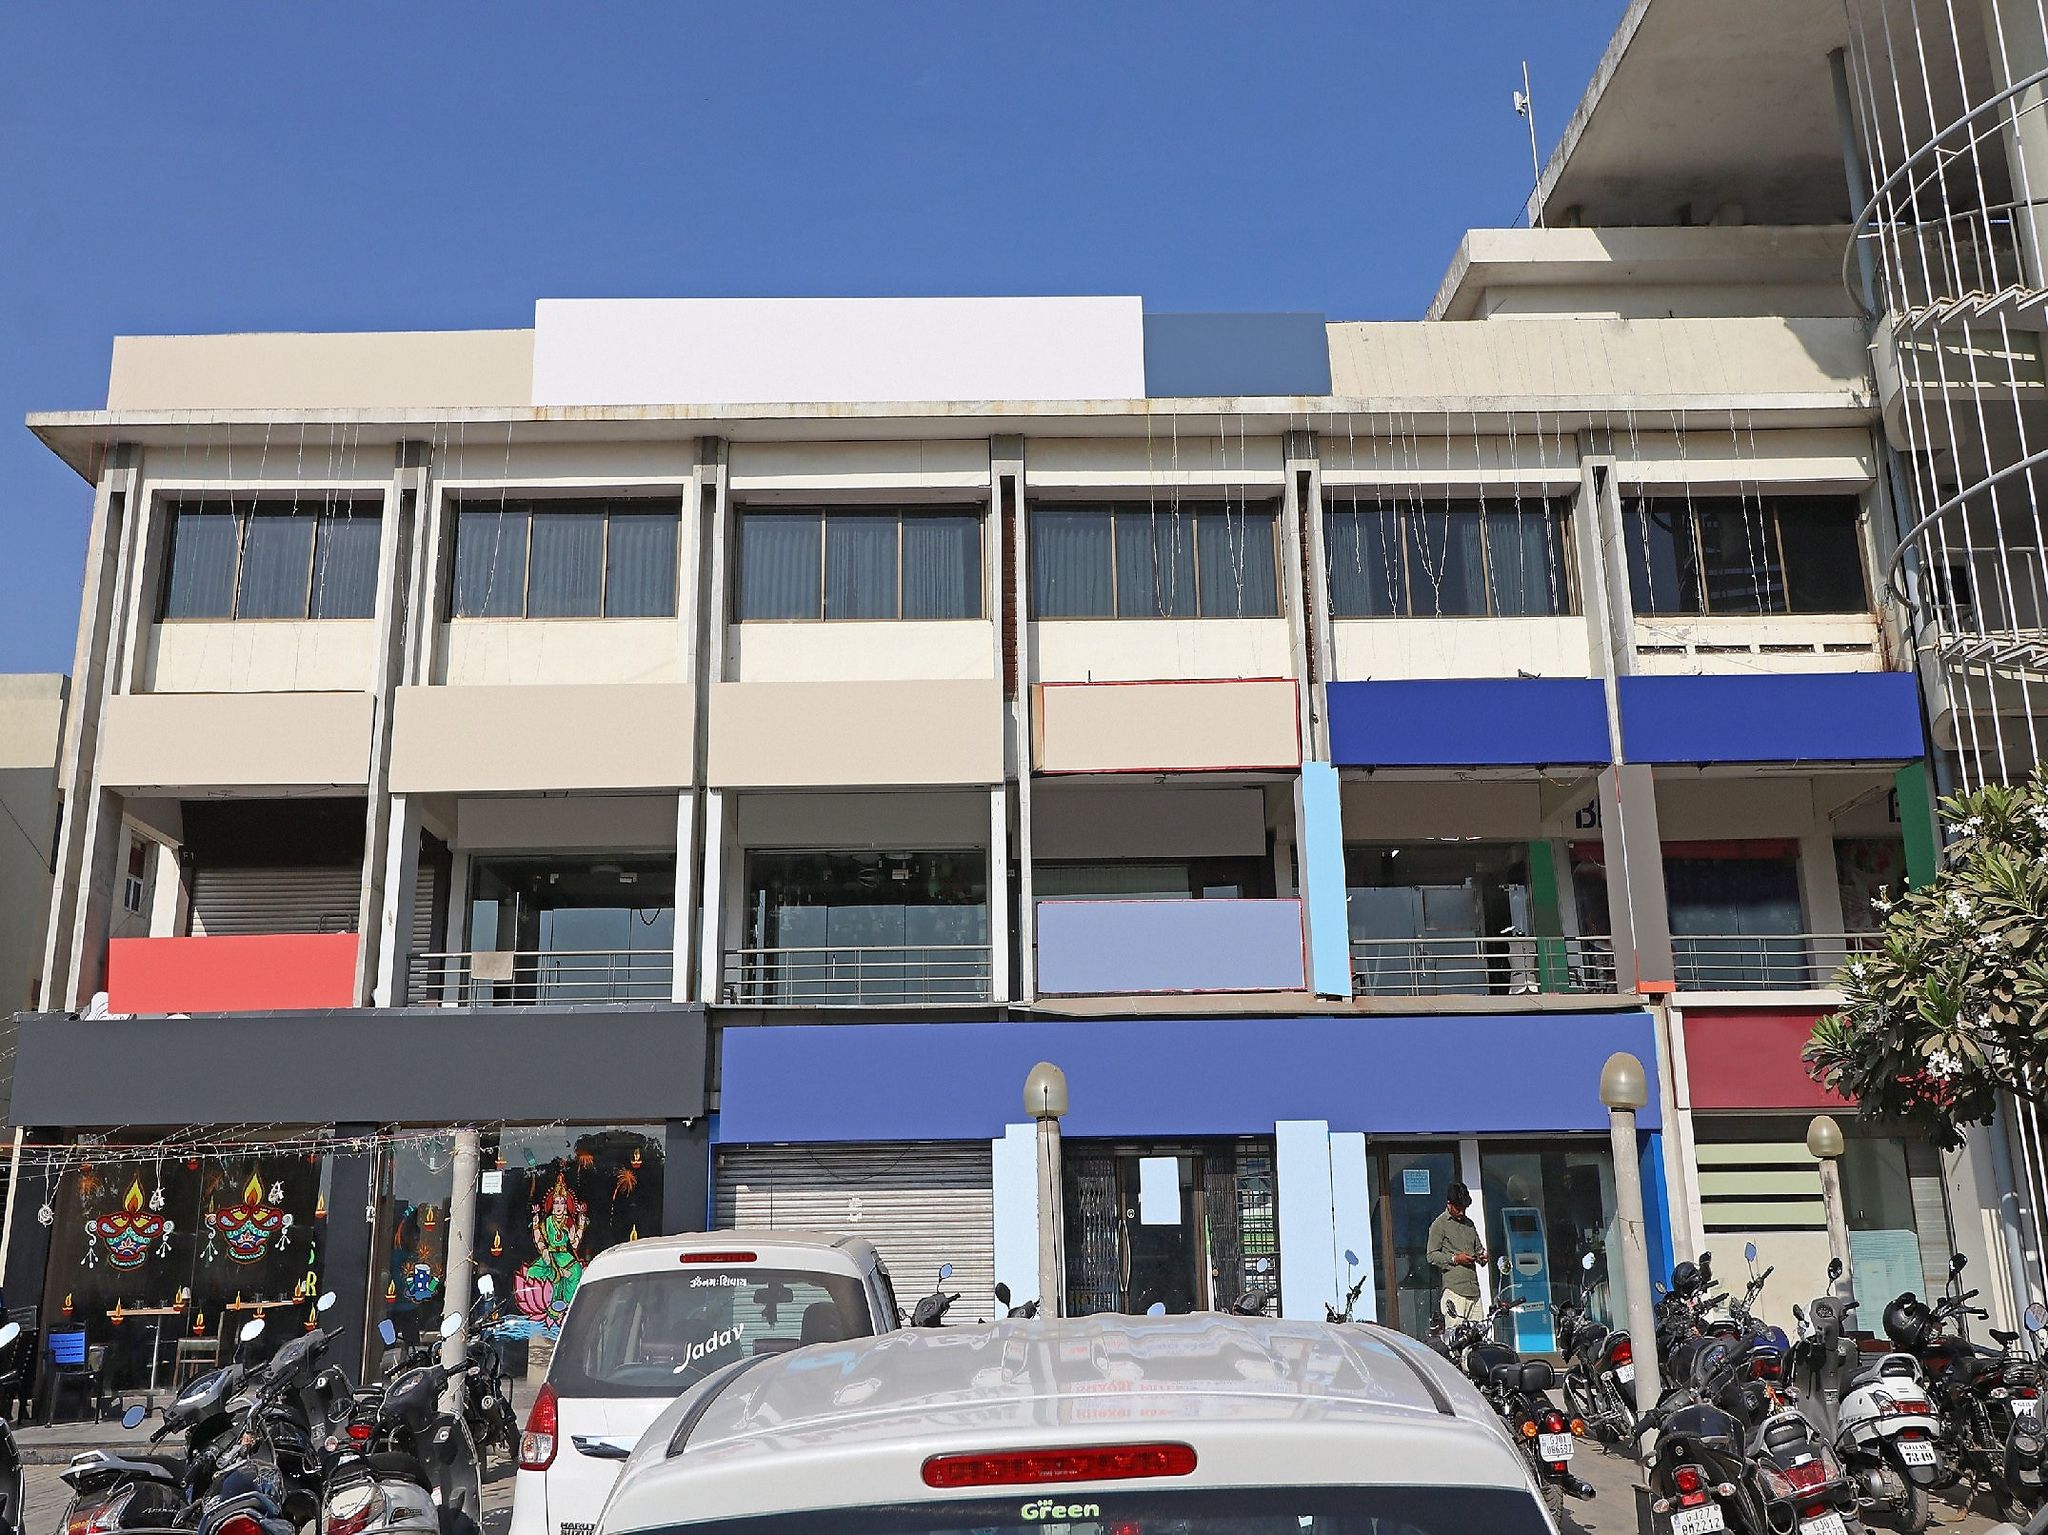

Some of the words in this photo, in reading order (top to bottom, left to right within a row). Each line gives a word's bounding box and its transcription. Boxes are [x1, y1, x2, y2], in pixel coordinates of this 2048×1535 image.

[673, 1322, 744, 1374] Jadav
[1021, 1501, 1100, 1520] Green
[1686, 1507, 1710, 1523] GJ27
